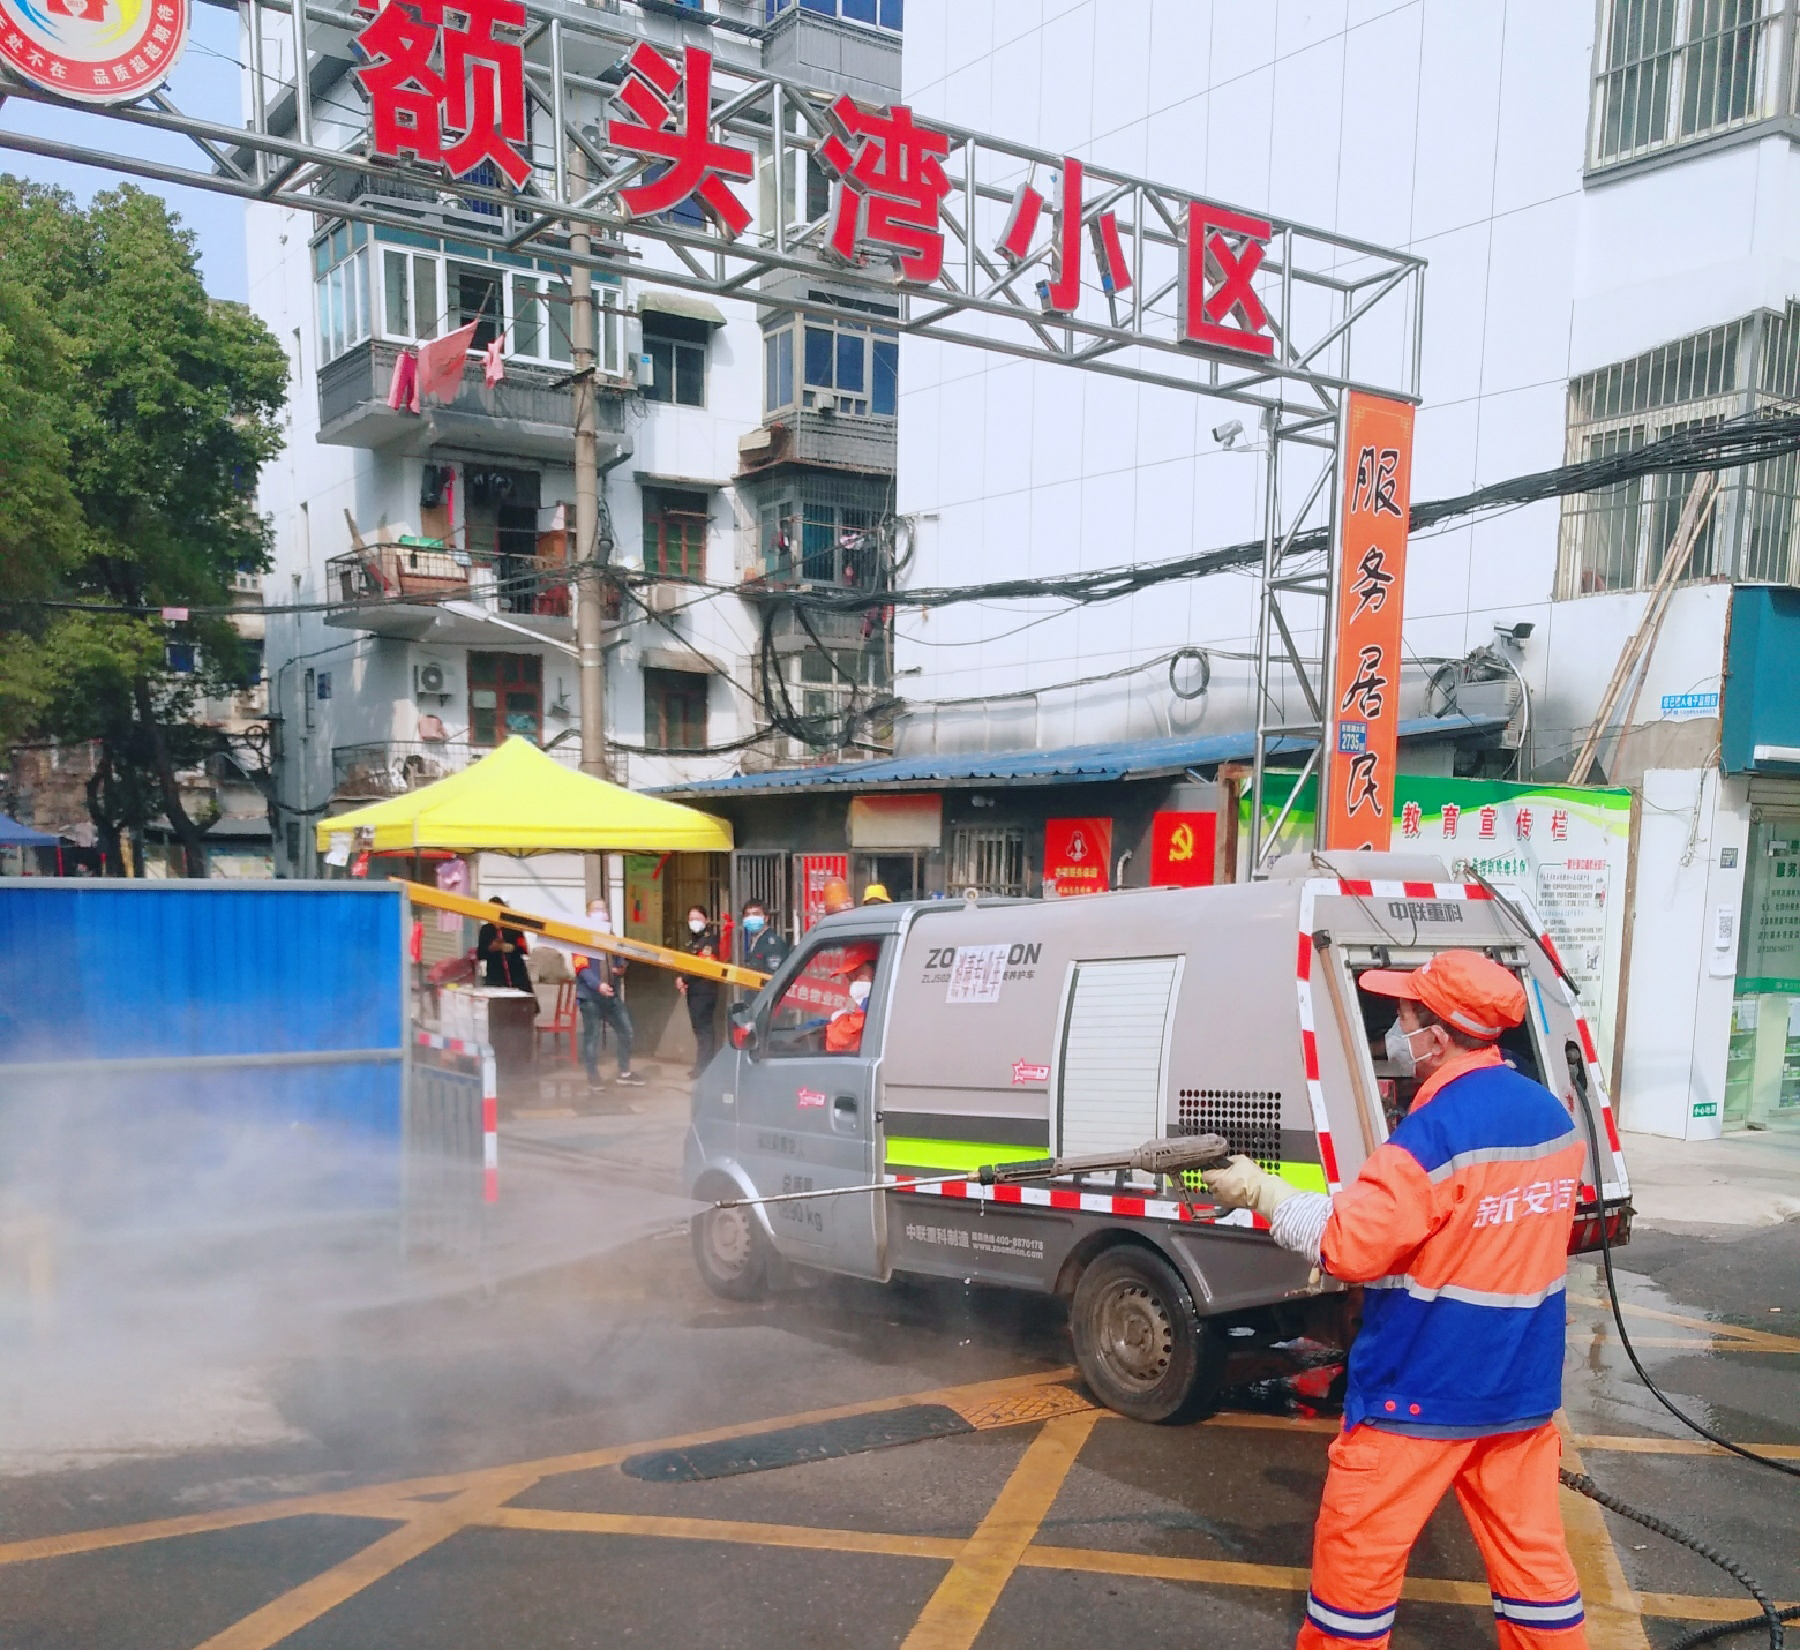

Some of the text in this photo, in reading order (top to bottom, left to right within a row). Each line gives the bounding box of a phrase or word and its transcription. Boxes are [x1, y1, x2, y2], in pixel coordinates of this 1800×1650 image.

[352, 0, 1275, 358] 额头湾小区
[1341, 446, 1403, 851] 服务居民
[1402, 801, 1569, 841] 教育宣传栏
[1776, 861, 1800, 878] 服务
